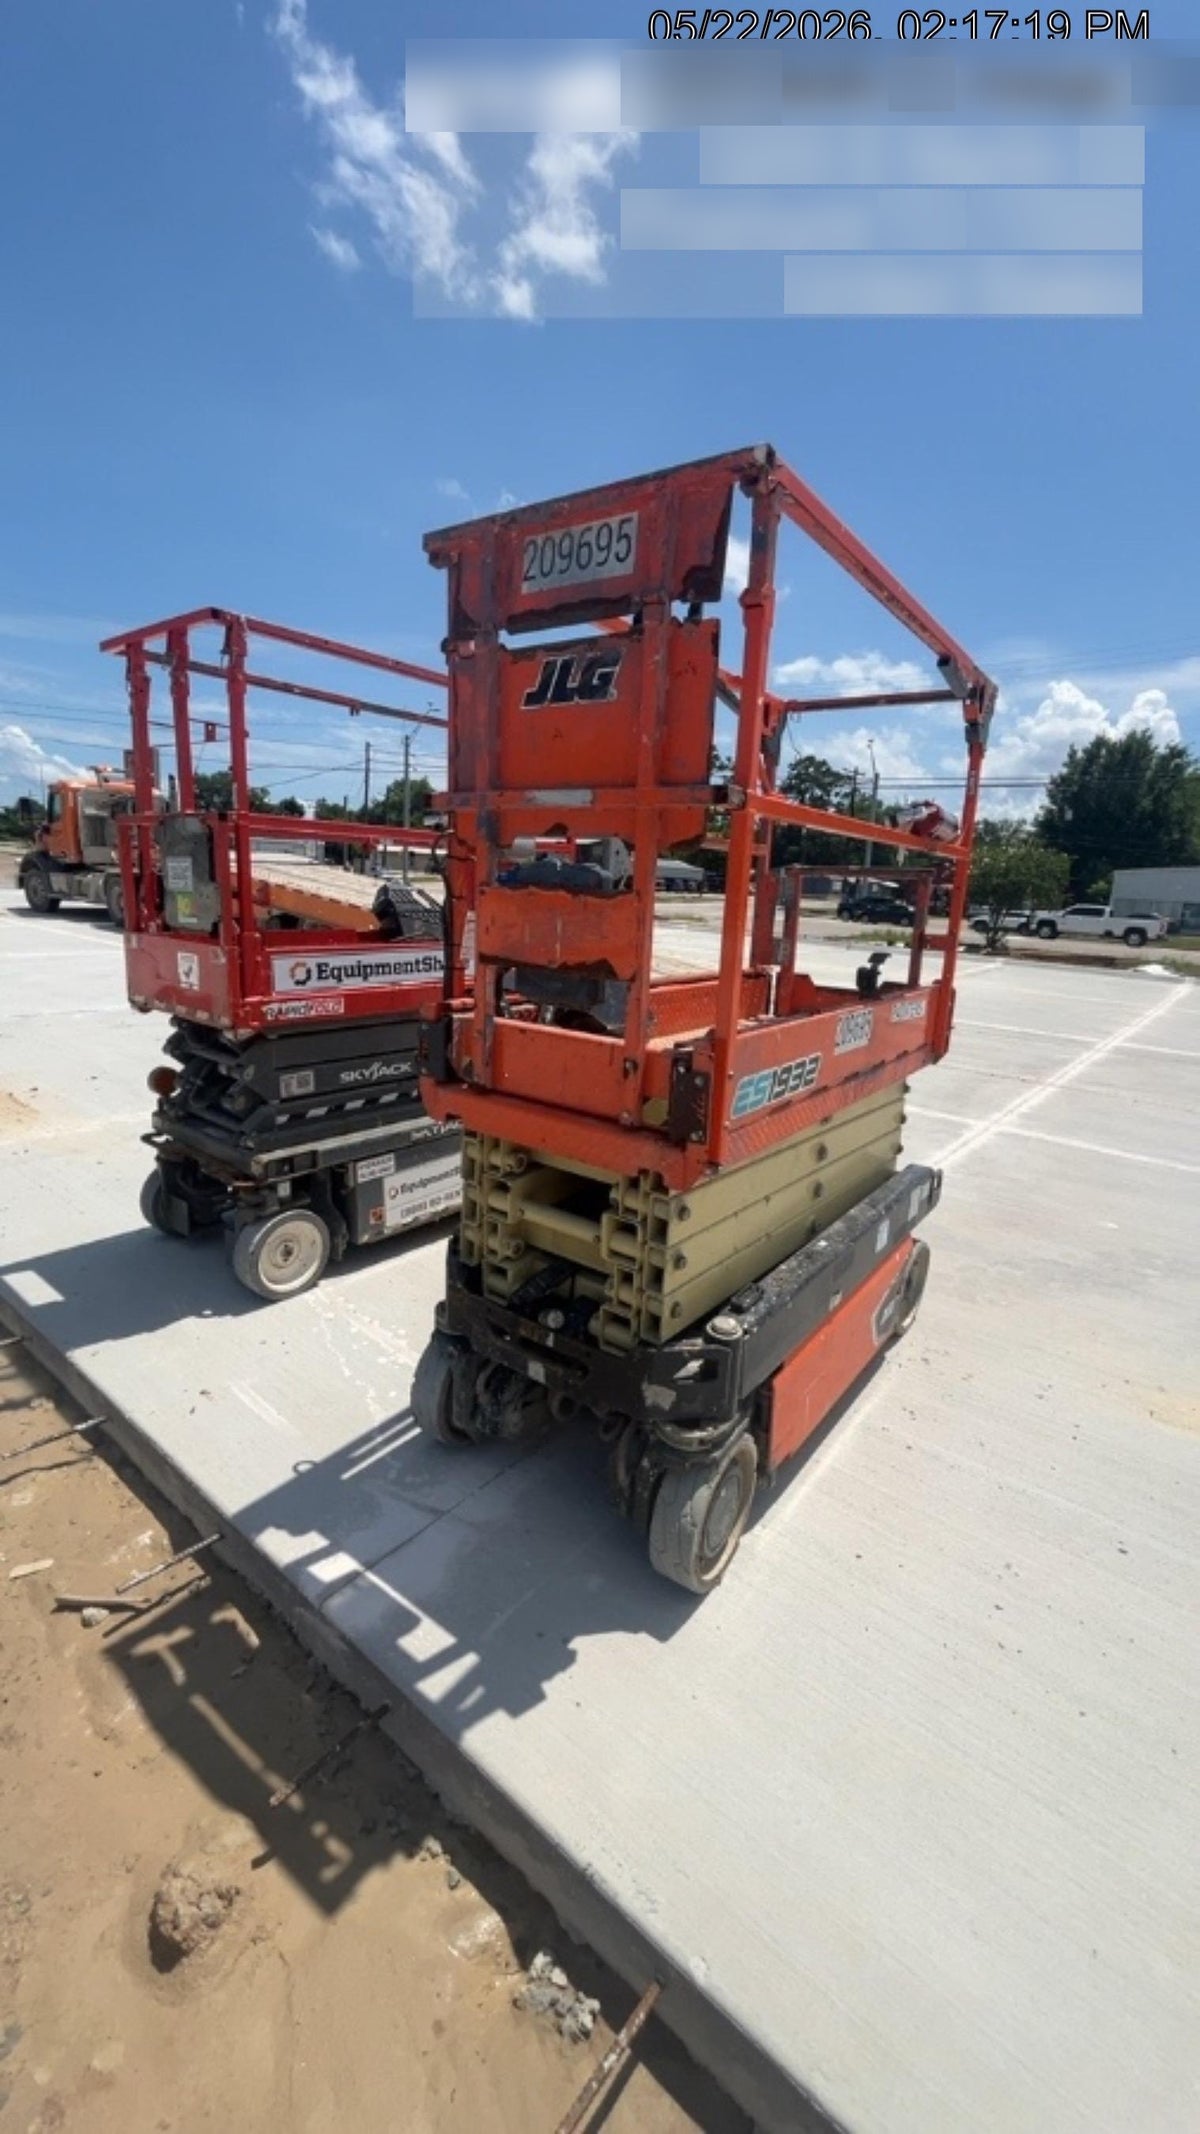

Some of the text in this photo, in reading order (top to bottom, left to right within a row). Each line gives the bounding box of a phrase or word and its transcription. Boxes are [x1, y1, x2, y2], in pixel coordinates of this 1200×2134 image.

[523, 517, 633, 581] 209695
[521, 649, 625, 709] JLG
[316, 956, 443, 983] EquipmentSh
[340, 1061, 413, 1083] SKYJACK
[731, 1053, 821, 1119] ES1932
